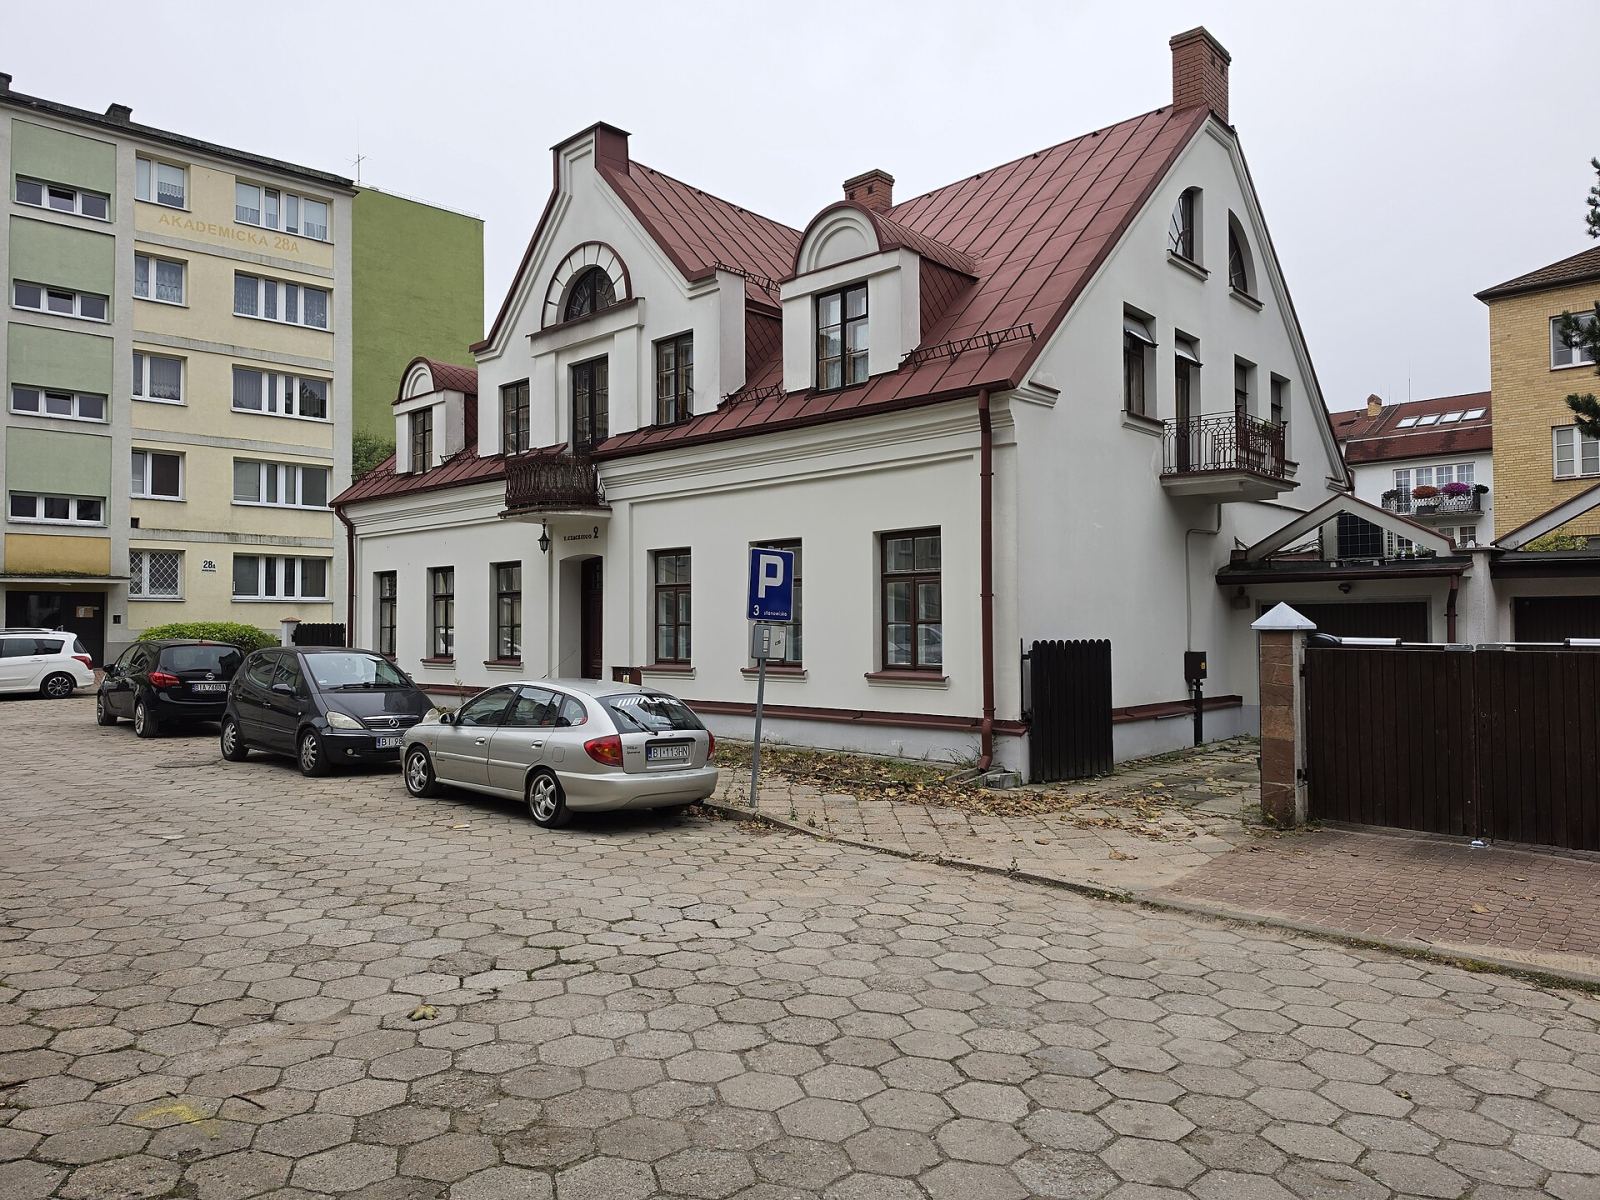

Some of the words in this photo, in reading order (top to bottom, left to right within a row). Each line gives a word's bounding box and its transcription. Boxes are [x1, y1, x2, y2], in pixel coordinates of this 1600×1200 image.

[159, 213, 268, 247] AKADEMICKA
[274, 236, 300, 253] 28A
[593, 526, 598, 539] 2
[758, 554, 784, 598] P
[753, 604, 760, 616] 3
